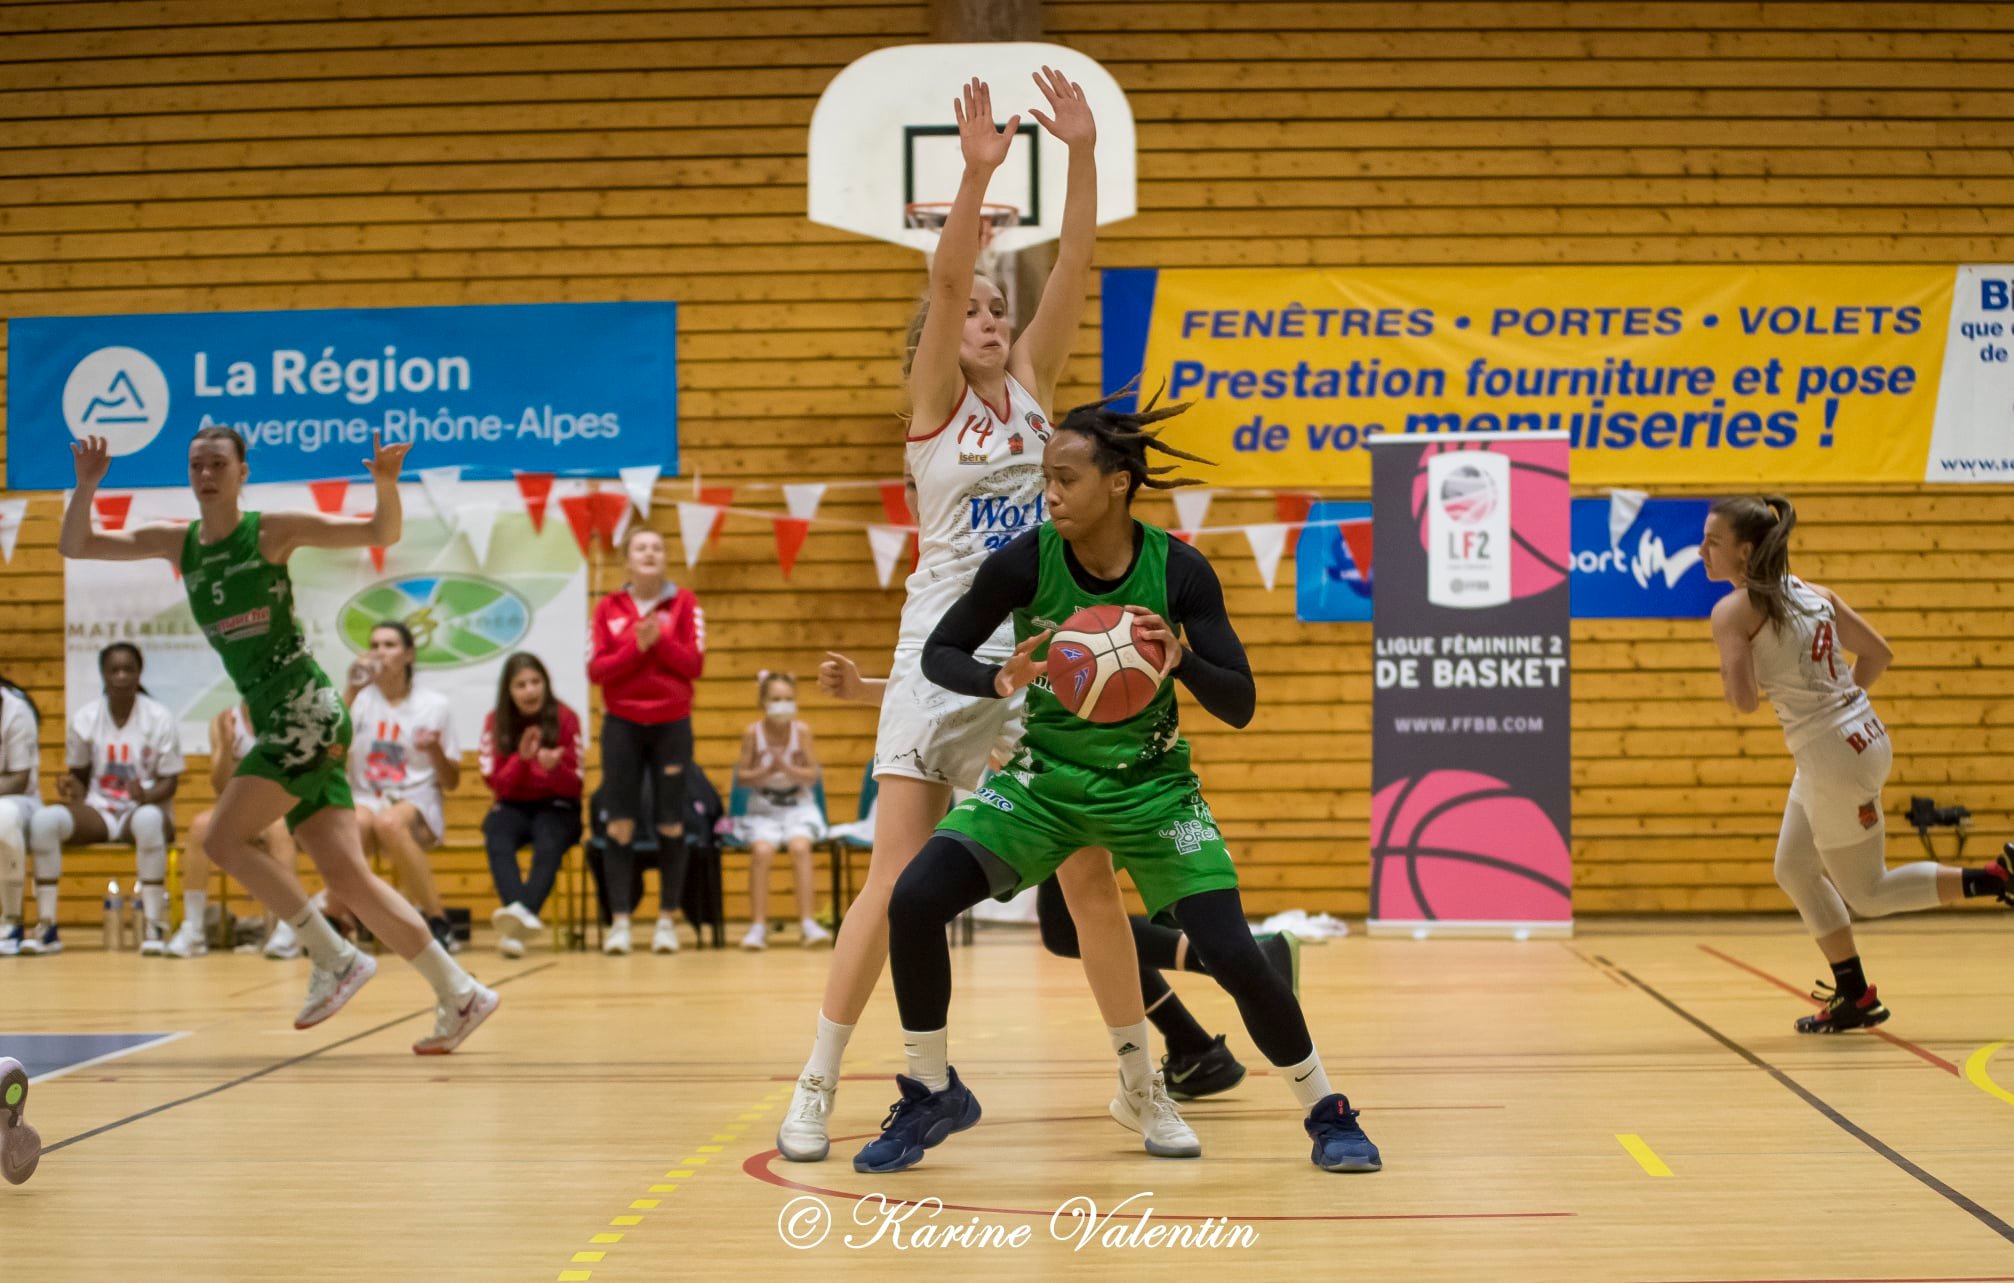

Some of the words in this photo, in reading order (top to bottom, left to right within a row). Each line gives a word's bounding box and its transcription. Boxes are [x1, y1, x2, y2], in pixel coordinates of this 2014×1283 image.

[1981, 279, 2014, 311] B
[1182, 301, 1435, 338] FENÊTRES
[1491, 307, 1683, 336] PORTES
[1739, 306, 1923, 335] VOLETS
[1961, 322, 2004, 341] que
[1980, 342, 2009, 362] de
[195, 352, 256, 396] La
[272, 345, 470, 404] Région
[1168, 359, 1446, 400] Prestation
[1466, 357, 1716, 398] fourniture
[1732, 357, 1783, 396] et
[1796, 364, 1917, 404] pose
[957, 414, 994, 448] 14
[1232, 415, 1290, 452] de
[1819, 397, 1840, 448] !
[1448, 530, 1490, 560] LF2
[211, 581, 225, 605] 5
[1376, 637, 1434, 656] LIGUE
[1441, 634, 1542, 655] FÉMININE
[1549, 637, 1562, 653] 2
[1376, 659, 1419, 688] DE
[1433, 658, 1566, 687] BASKET
[1394, 717, 1543, 732] WWW.FFBB.COM
